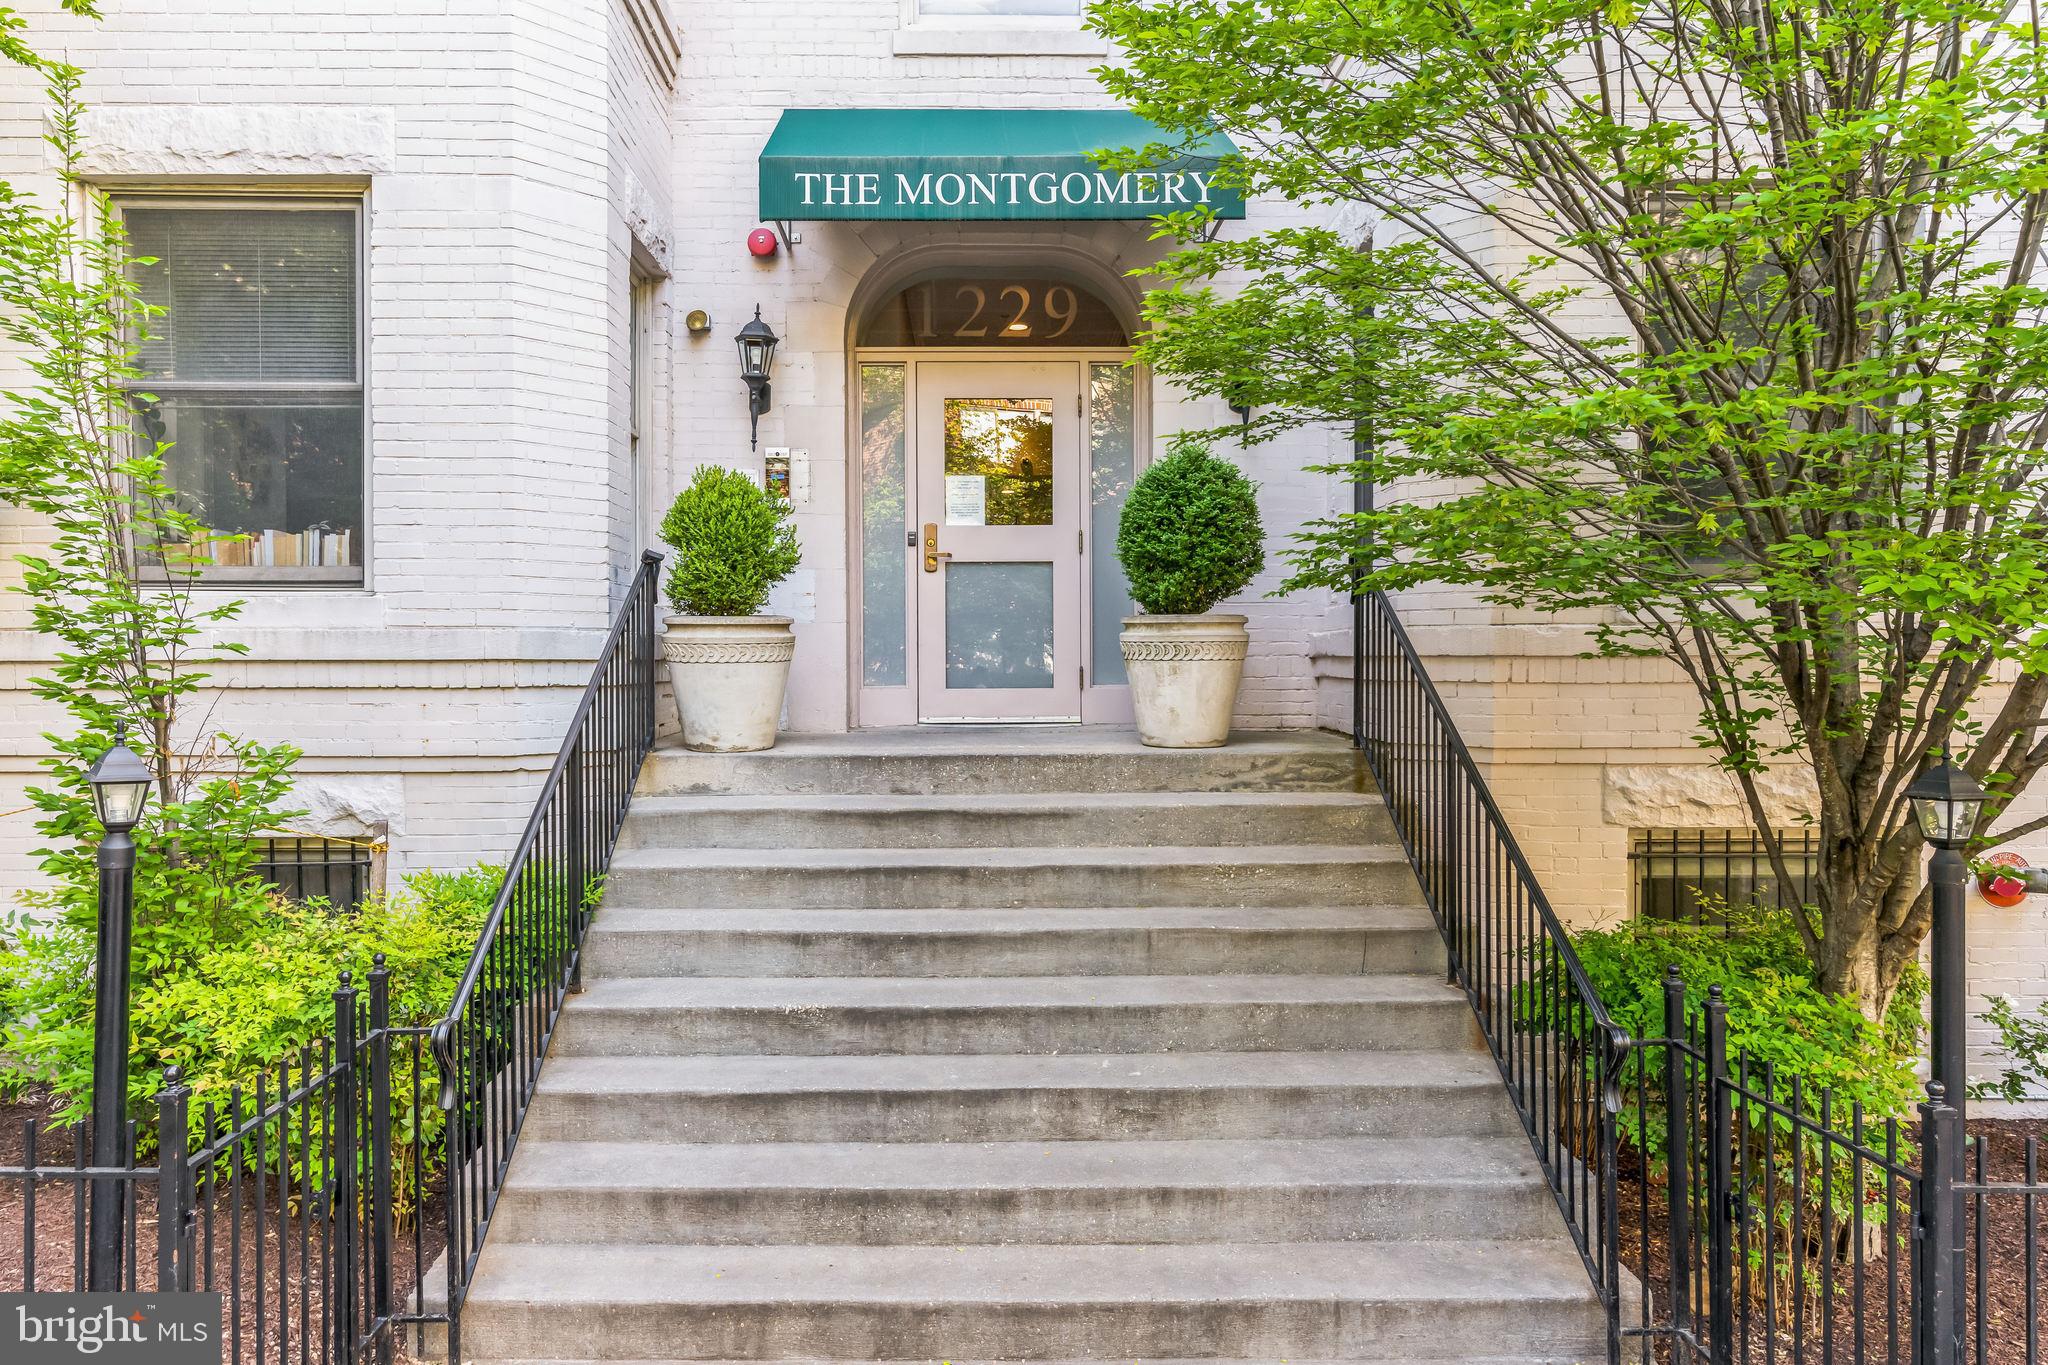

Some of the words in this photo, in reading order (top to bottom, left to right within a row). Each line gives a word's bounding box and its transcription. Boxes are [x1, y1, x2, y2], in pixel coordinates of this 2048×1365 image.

[794, 172, 882, 206] THE
[893, 171, 1217, 206] MONTGOMERY
[915, 282, 1079, 339] 1229
